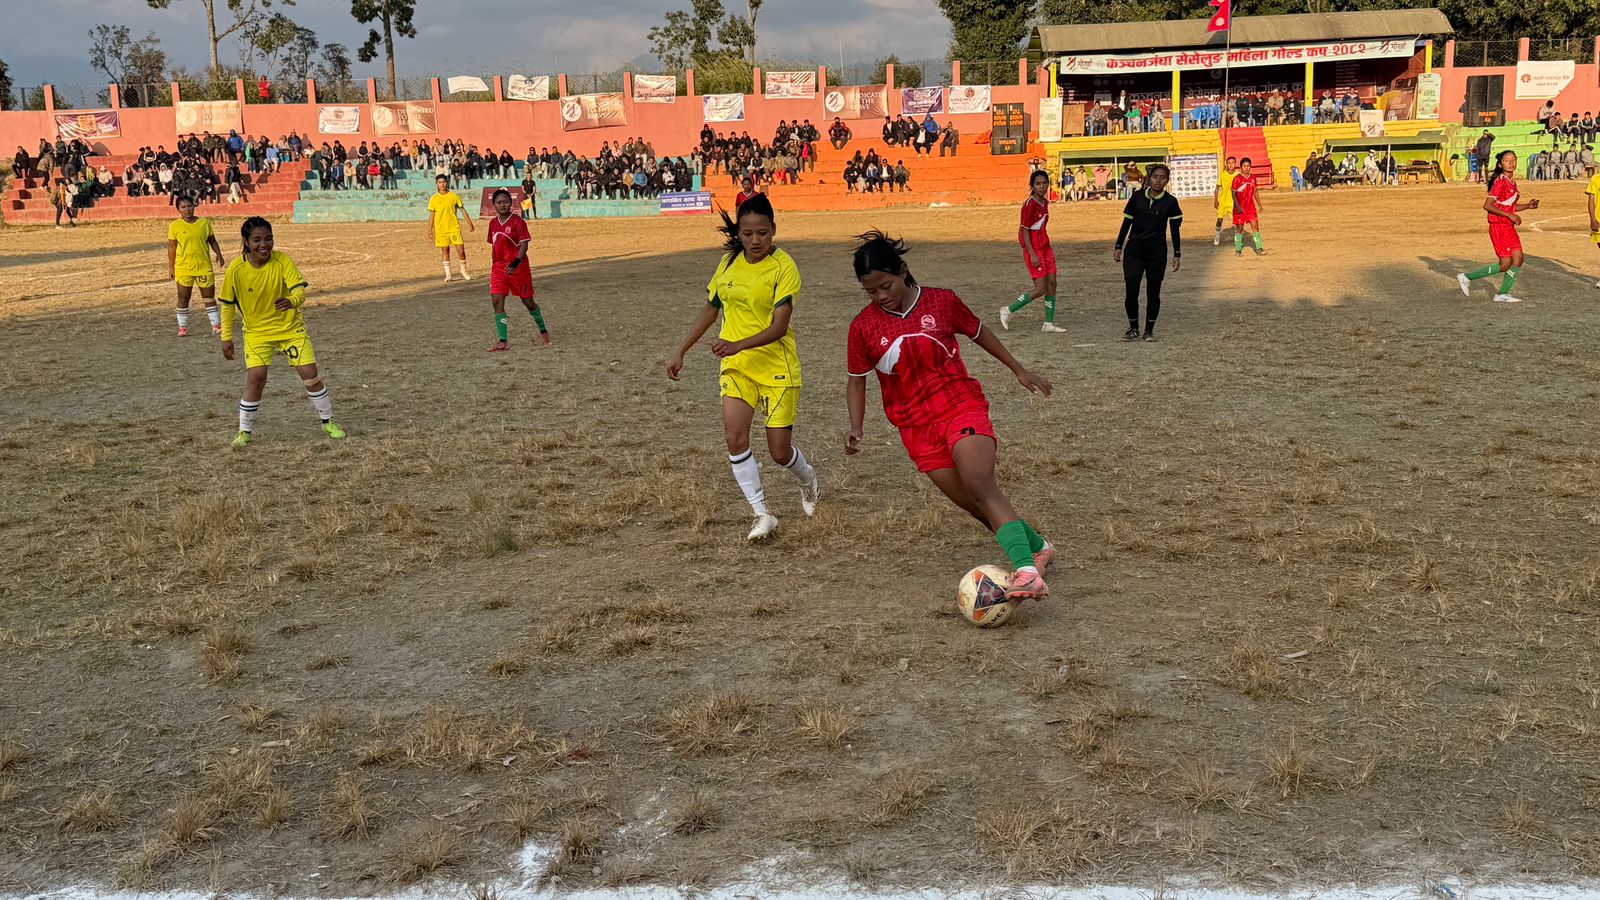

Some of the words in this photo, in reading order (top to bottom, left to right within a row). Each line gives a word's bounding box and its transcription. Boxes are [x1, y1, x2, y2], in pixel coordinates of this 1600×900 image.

[1175, 52, 1224, 67] सेसेलुङ
[1227, 48, 1269, 62] महिला
[1272, 46, 1304, 59] गोल्ड
[1306, 47, 1328, 57] कप
[1332, 43, 1366, 56] २०८२
[452, 234, 458, 242] 6
